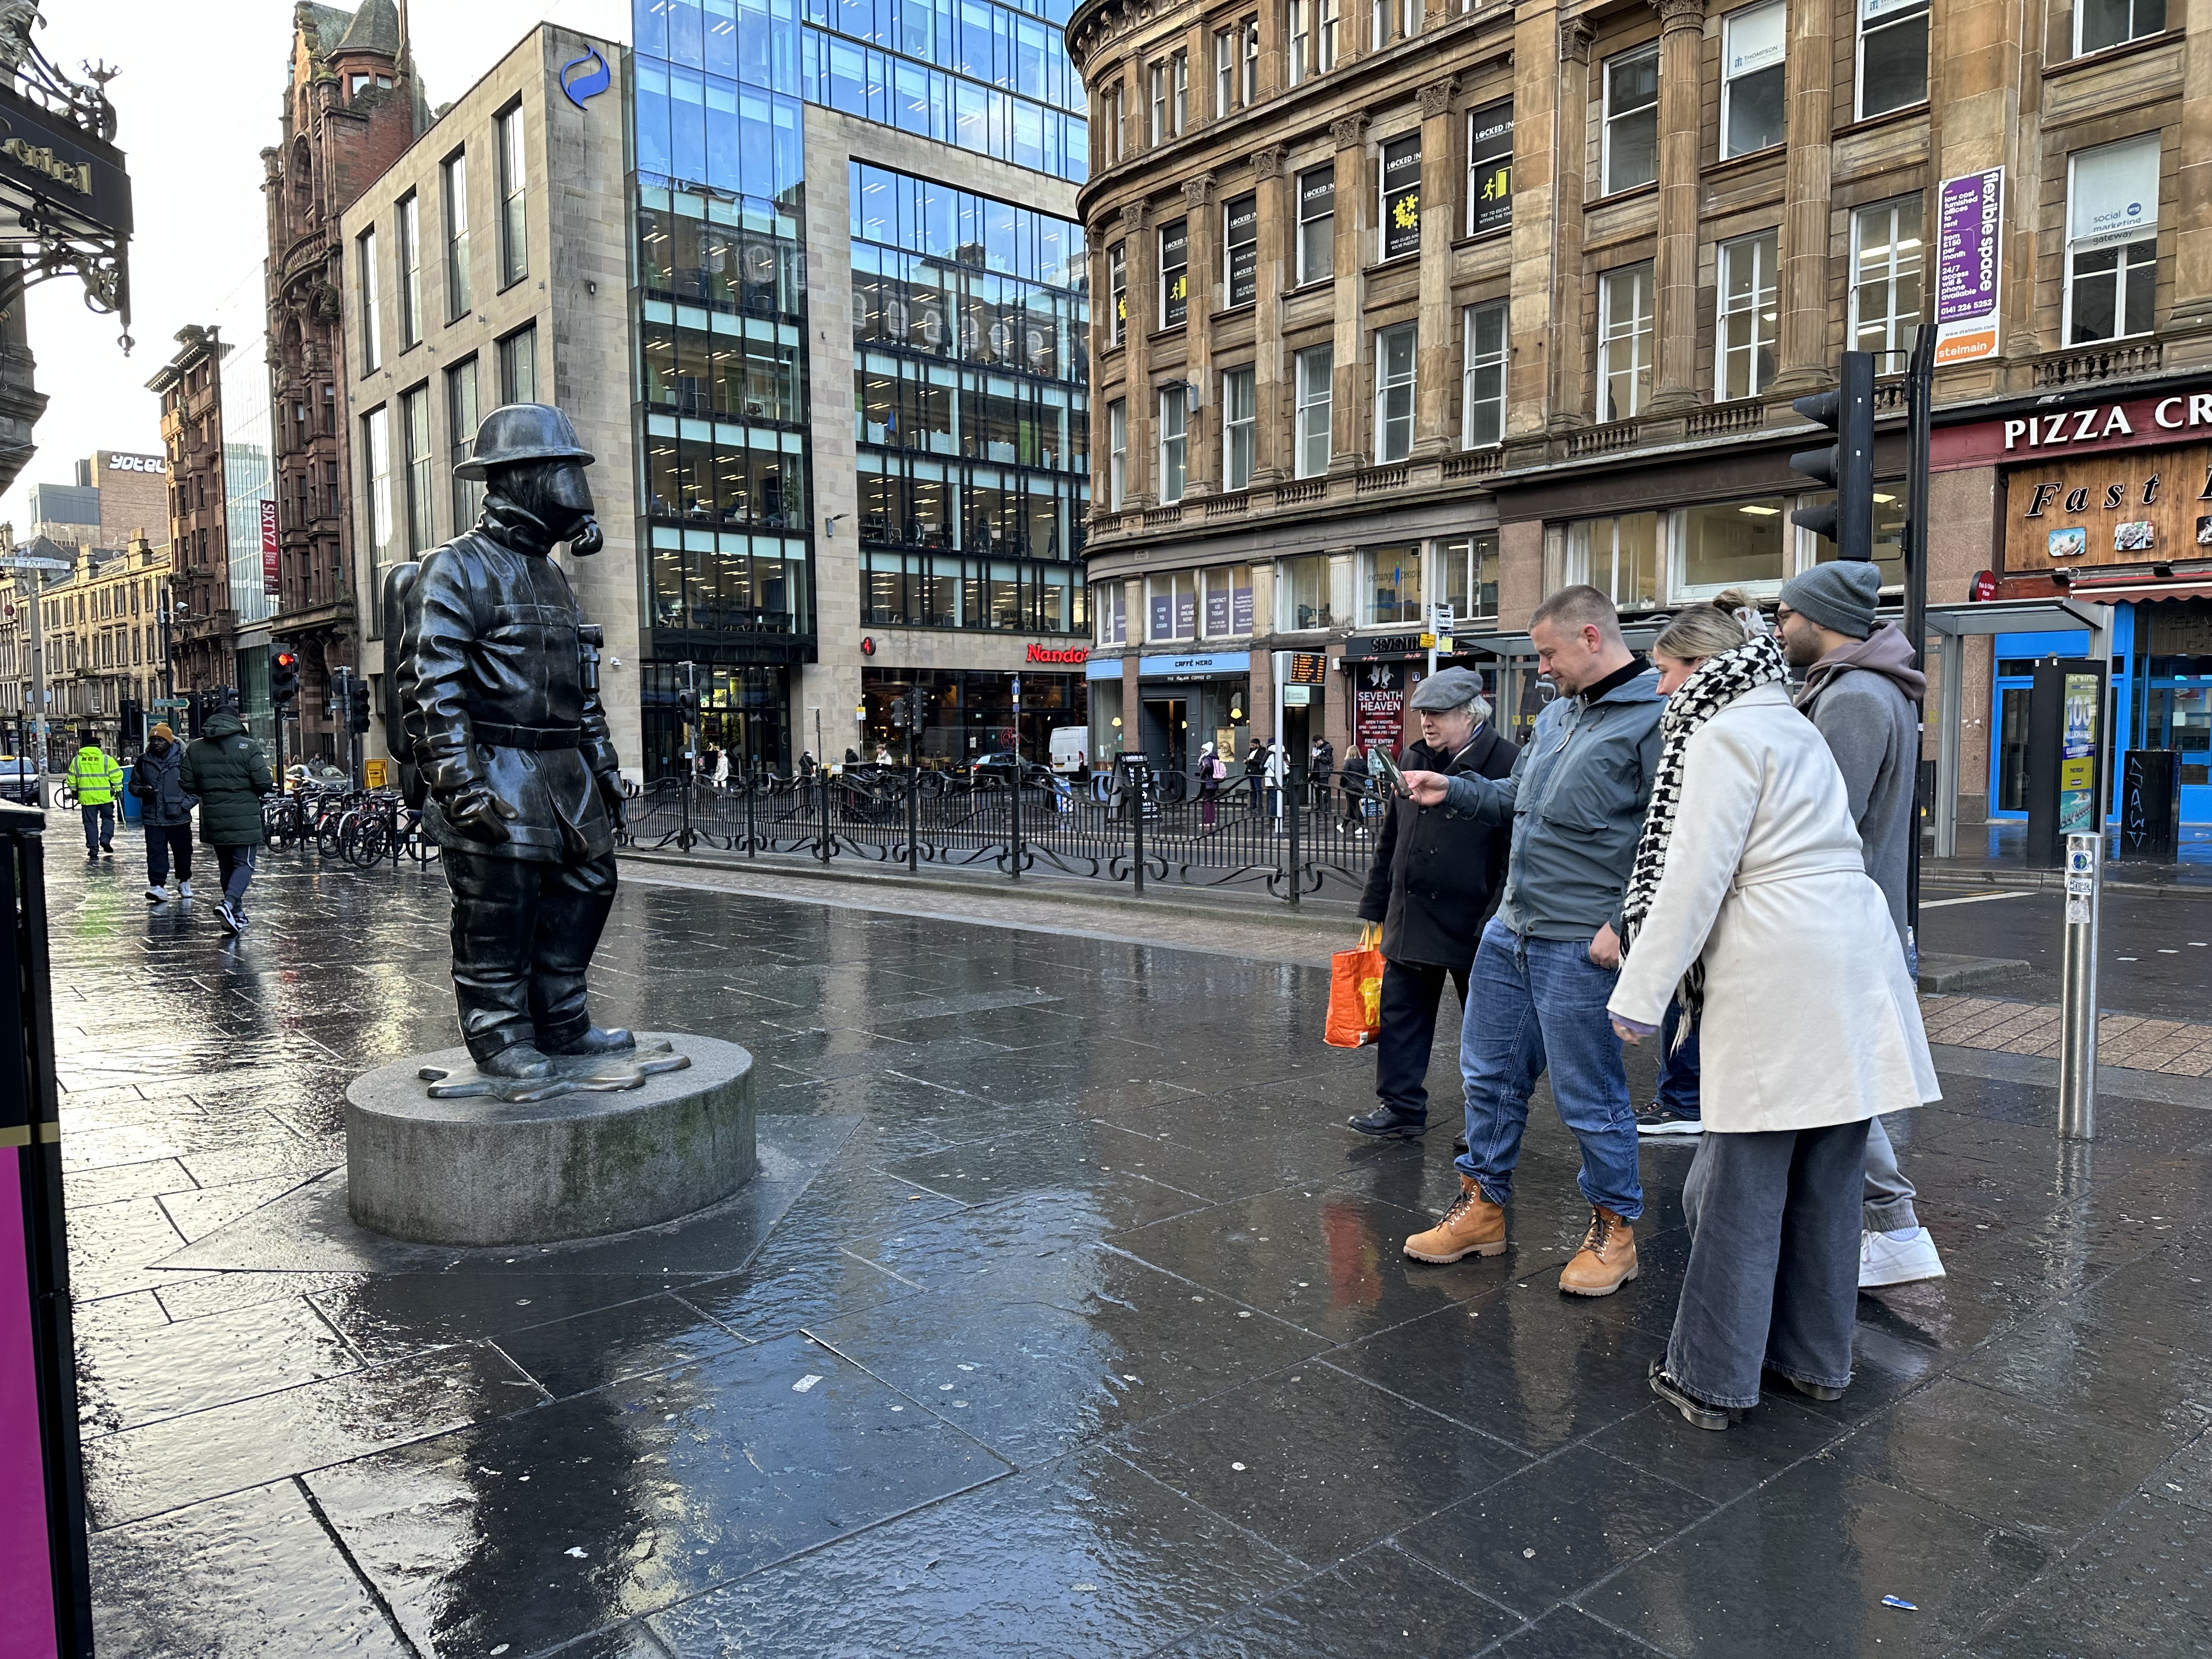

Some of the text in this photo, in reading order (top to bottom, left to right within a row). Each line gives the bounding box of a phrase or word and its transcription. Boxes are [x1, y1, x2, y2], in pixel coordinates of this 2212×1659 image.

[1744, 45, 1778, 61] THOMPSON
[1475, 124, 1503, 140] LOCKED
[1505, 120, 1514, 130] IN
[1387, 155, 1412, 170] LOCKED
[1414, 151, 1421, 160] IN
[1304, 185, 1327, 199] LOCKED
[1944, 189, 1975, 203] low cost
[1944, 195, 1978, 209] furnished
[1981, 172, 1999, 235] flexible
[1944, 205, 1968, 215] offices
[2094, 210, 2121, 223] social
[1230, 213, 1251, 227] LOCKED
[1943, 219, 1958, 229] rent
[2094, 217, 2141, 232] marketing
[1165, 238, 1183, 250] LOCKED
[1403, 238, 1419, 247] PUZZLES
[1943, 233, 1960, 242] from
[1943, 239, 1961, 249] £150
[2093, 230, 2134, 245] gateway
[1235, 253, 1246, 262] BOOK
[1942, 250, 1966, 261] month
[1943, 247, 1955, 256] per
[1942, 265, 1960, 274] 24/7
[1977, 236, 1993, 291] space
[1234, 266, 1252, 278] LOCKED
[1942, 271, 1969, 281] access
[1941, 284, 1966, 295] phone
[1942, 279, 1955, 287] wifi
[1941, 289, 1977, 301] available
[1940, 299, 1993, 315] 0141 226 5252
[1945, 324, 1995, 337] www.stelmain.com
[1938, 342, 1987, 358] stelmain
[2005, 405, 2133, 449] PIZZA
[110, 455, 167, 474] yotel
[2024, 473, 2160, 517] Fast
[262, 503, 276, 547] SIXTY7
[1368, 568, 1421, 583] exchange people
[1026, 643, 1090, 663] Nando'
[1175, 658, 1193, 667] CAFFÈ
[1358, 691, 1403, 701] SEVENTH
[1361, 701, 1401, 712] HEAVEN
[2066, 695, 2092, 727] 100
